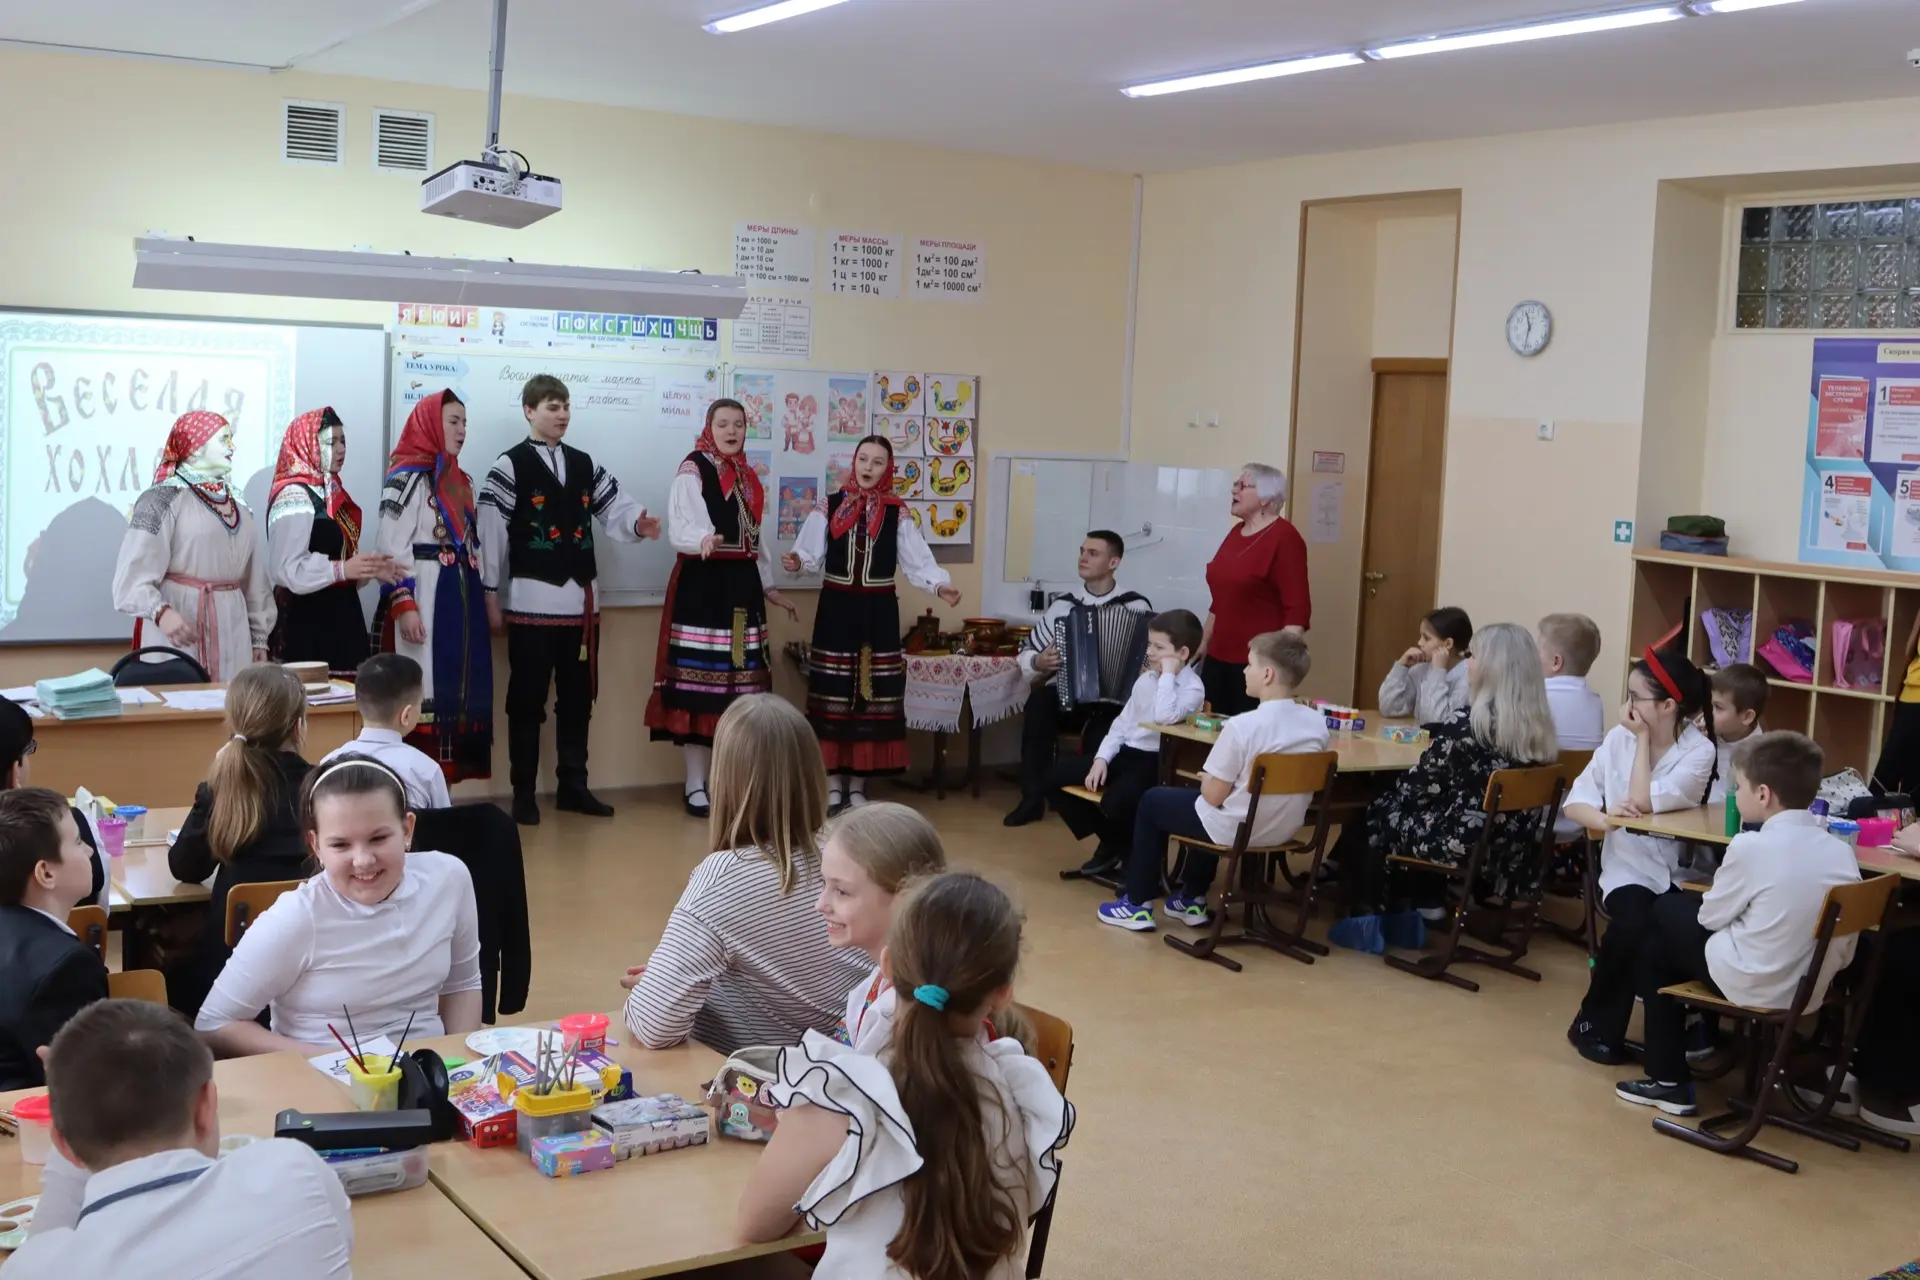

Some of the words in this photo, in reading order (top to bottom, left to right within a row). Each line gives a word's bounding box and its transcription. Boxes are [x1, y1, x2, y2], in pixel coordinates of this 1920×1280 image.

[746, 224, 769, 233] МЕРЫ
[770, 226, 798, 235] ДЛИНЫ
[862, 237, 888, 246] МАССЫ
[942, 242, 976, 250] ПЛОЩАДИ
[862, 246, 882, 255] 1000
[861, 258, 882, 268] 1000
[944, 256, 959, 266] 100
[860, 272, 876, 281] 100
[944, 269, 958, 278] 100
[860, 285, 871, 294] 10
[943, 282, 965, 292] 10000
[406, 361, 428, 370] ТЕМА
[601, 375, 641, 388] марта
[1880, 385, 1887, 401] 1
[662, 407, 690, 416] МИЛАЯ
[1825, 475, 1834, 489] 4
[1900, 480, 1909, 494] 5
